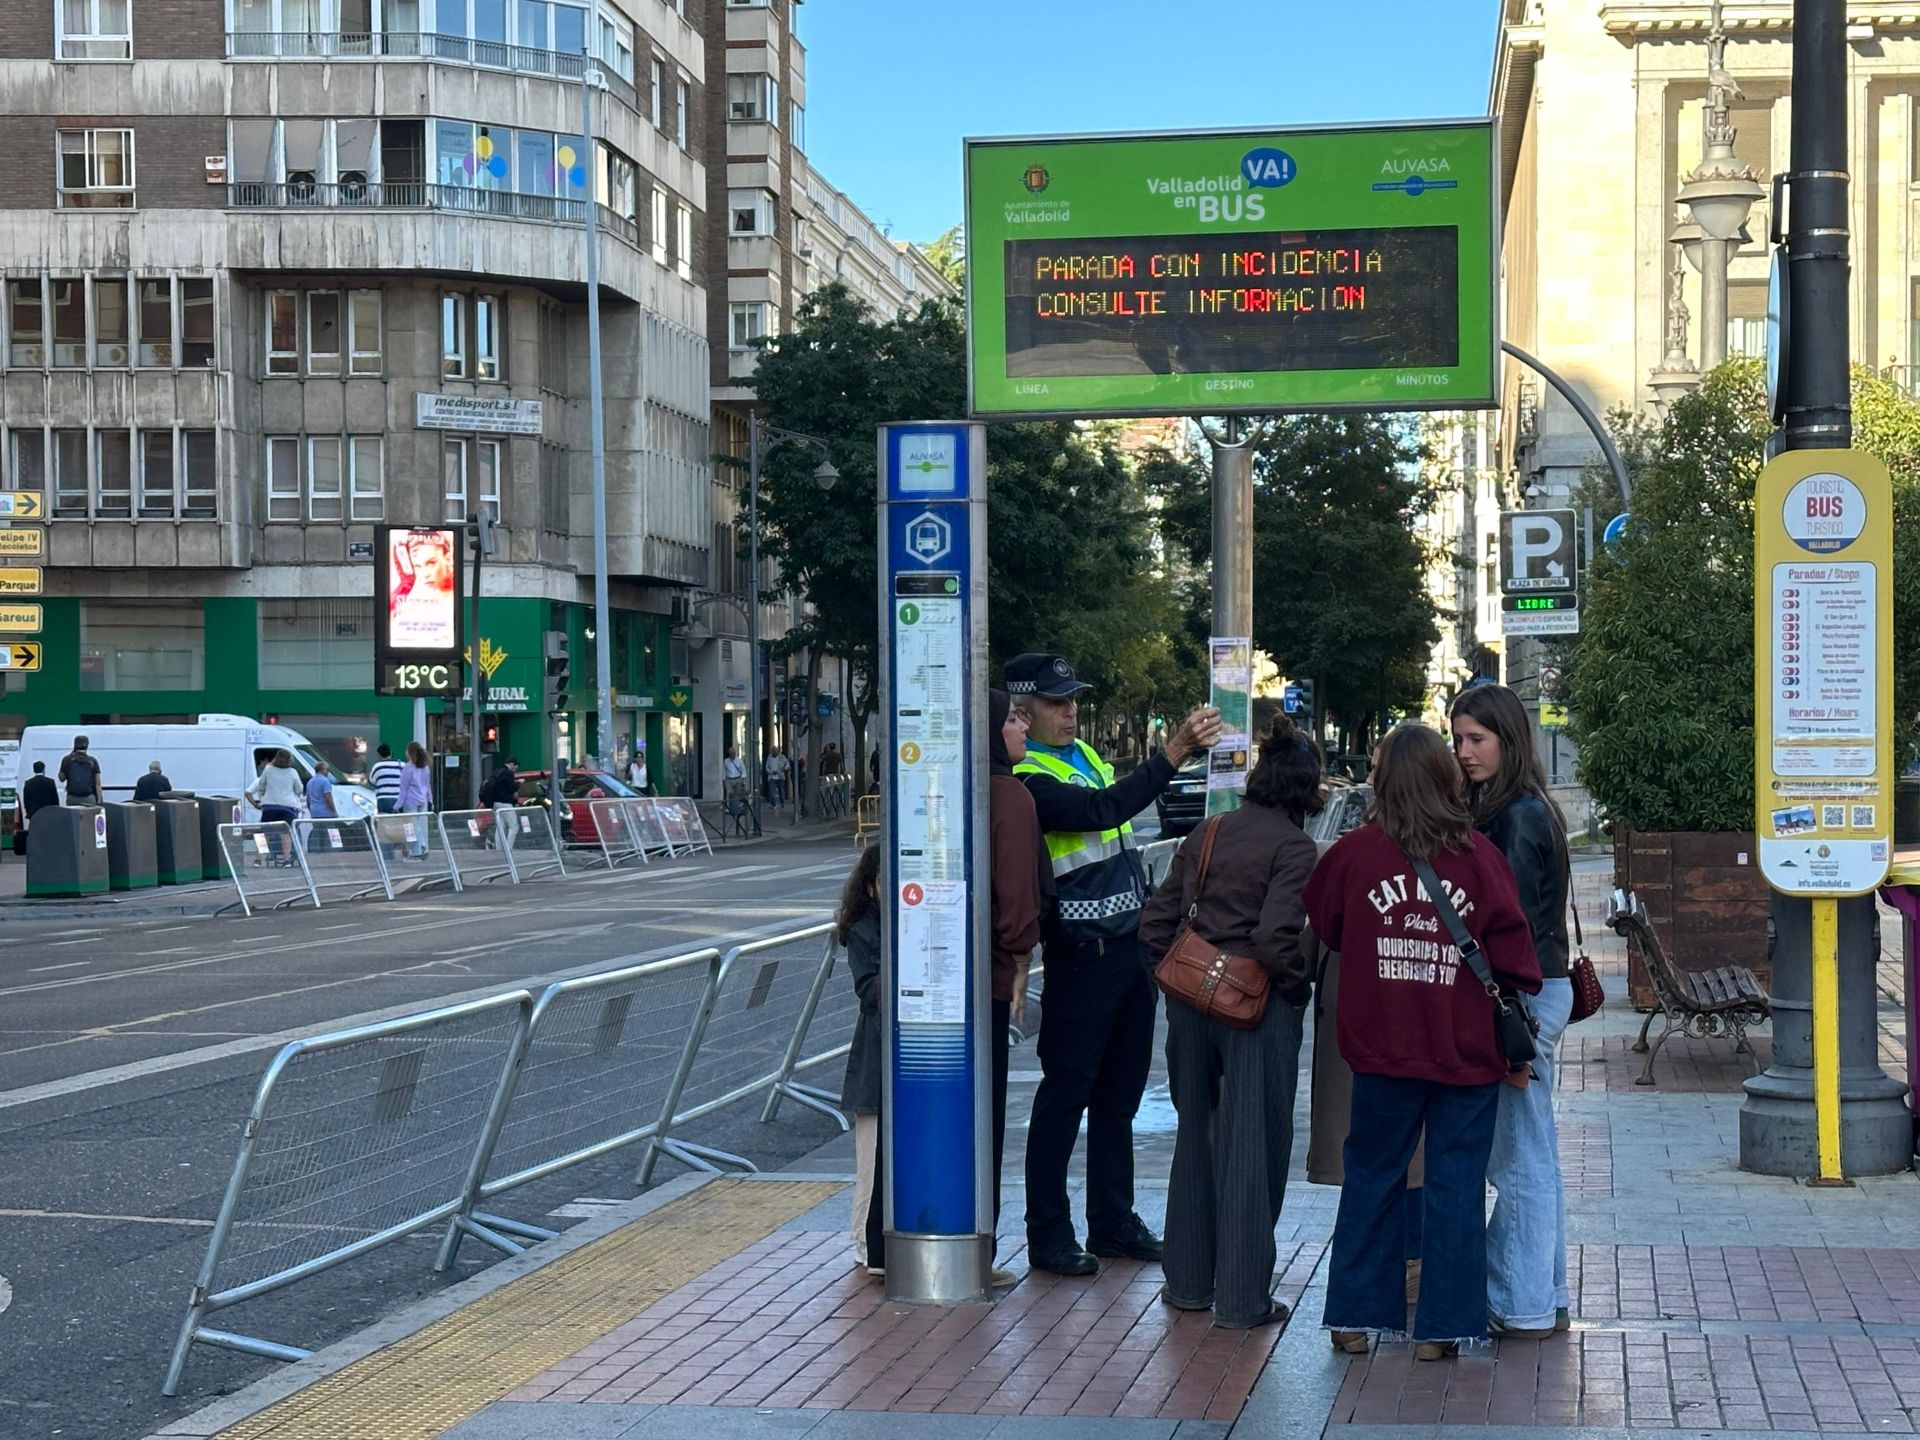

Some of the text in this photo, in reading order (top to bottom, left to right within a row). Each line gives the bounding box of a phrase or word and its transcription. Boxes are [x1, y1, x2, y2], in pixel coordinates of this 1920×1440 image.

[1247, 158, 1289, 180] VA!
[1381, 157, 1450, 174] AUVASA
[1147, 175, 1242, 194] Valladolid
[1174, 193, 1265, 222] en BUS
[1005, 210, 1070, 223] Valladolid
[1037, 248, 1382, 281] PARADA CON INCIDENCIA
[1038, 285, 1366, 317] CONSULTE INFORMACION
[1205, 379, 1255, 391] DESTINO
[1396, 374, 1449, 386] MINUTOS
[1806, 480, 1844, 494] TOURISTIC
[1806, 496, 1843, 518] BUS
[0, 533, 38, 542] elipe IV
[1788, 568, 1826, 580] Paradas
[1834, 568, 1860, 580] Stops
[0, 581, 36, 591] Parque
[1518, 599, 1554, 609] LIBRE
[905, 607, 912, 621] 1
[395, 665, 448, 689] 13°C
[1789, 707, 1826, 718] Horarios
[1834, 707, 1859, 718] Hours
[905, 746, 914, 760] 2
[908, 887, 918, 902] 4
[1367, 874, 1408, 914] EAT
[1377, 936, 1439, 961] NOURISHING
[1378, 959, 1457, 986] ENERGISING YOU
